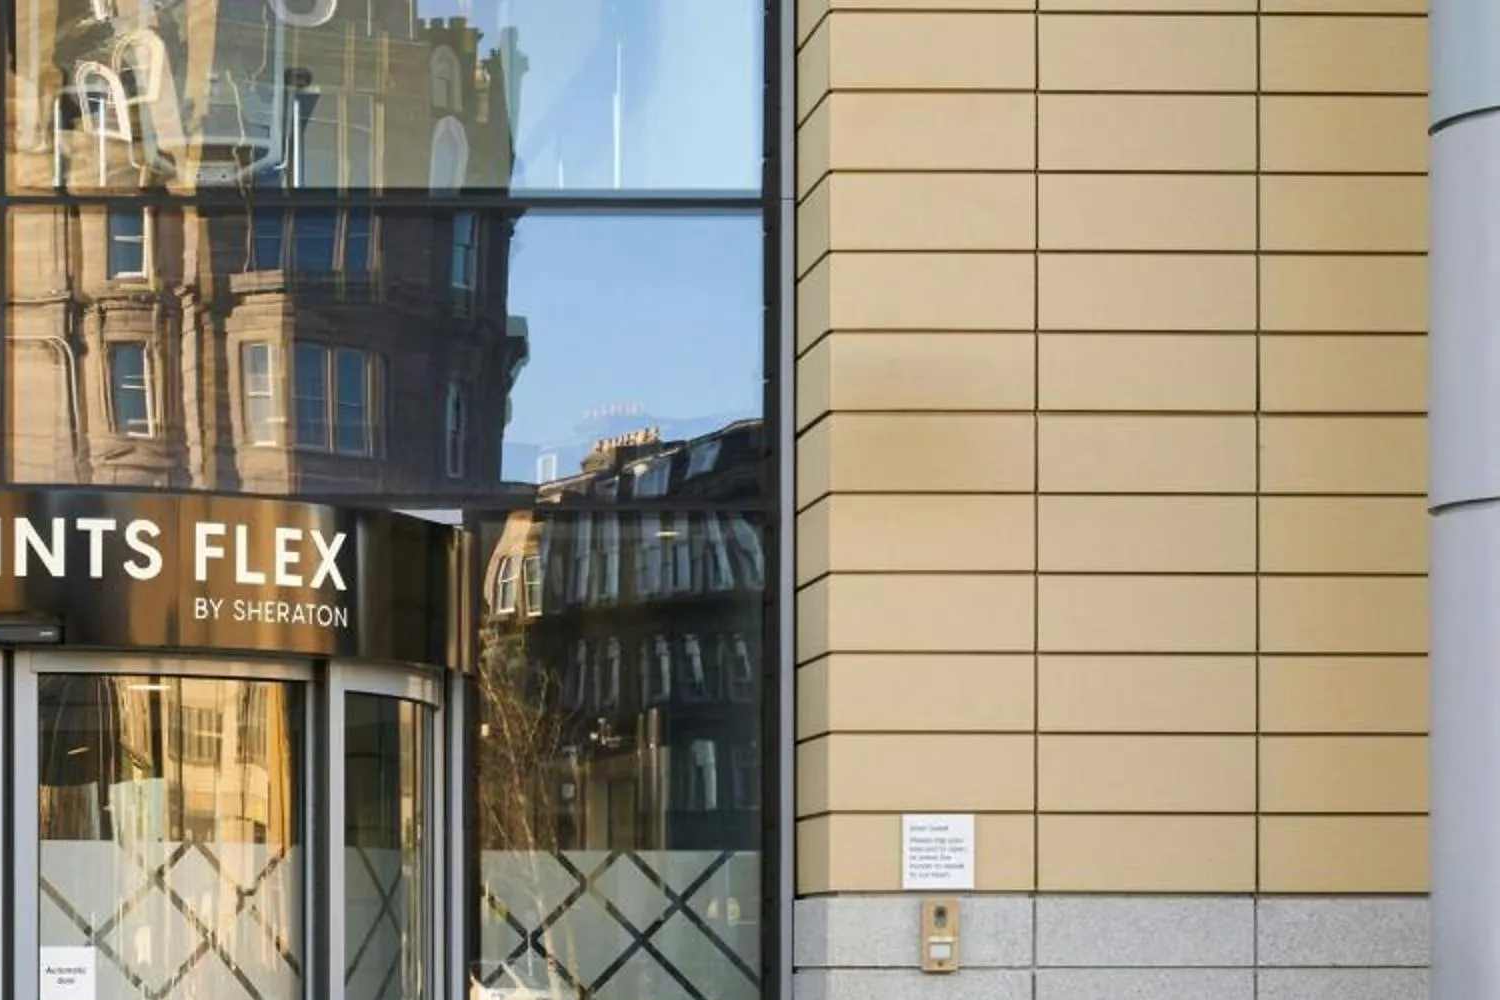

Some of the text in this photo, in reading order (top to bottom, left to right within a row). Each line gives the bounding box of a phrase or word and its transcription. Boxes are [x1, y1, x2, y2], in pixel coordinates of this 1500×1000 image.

[195, 523, 347, 591] FLEX
[194, 597, 348, 628] BY SHERATON
